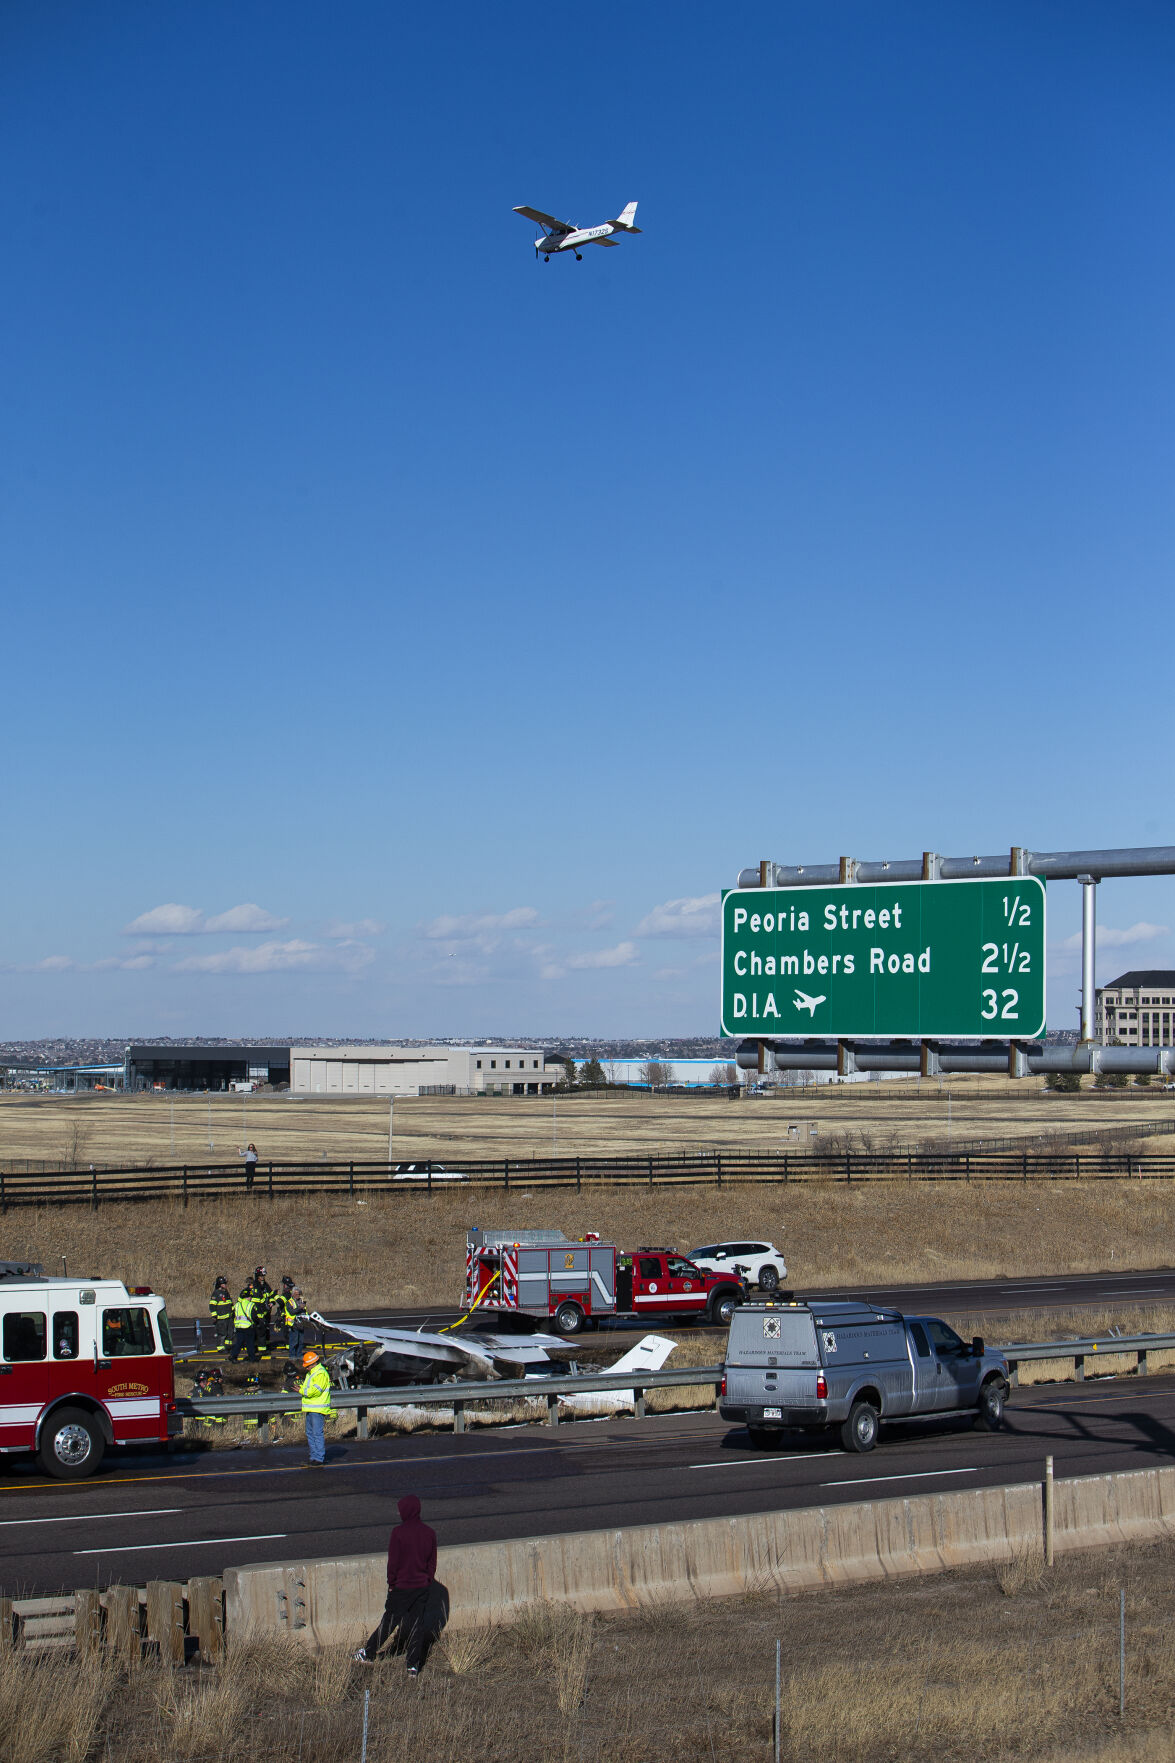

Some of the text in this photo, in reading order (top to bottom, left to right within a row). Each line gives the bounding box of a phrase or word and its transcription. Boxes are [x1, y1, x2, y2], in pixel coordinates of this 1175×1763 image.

[734, 905, 809, 933] Peoria
[823, 902, 902, 931] Street
[734, 949, 855, 976] Chambers
[870, 946, 931, 974] Road
[733, 988, 1019, 1020] D.I.A. 32
[564, 1254, 575, 1269] 2
[107, 1382, 149, 1394] SOUTH METRO
